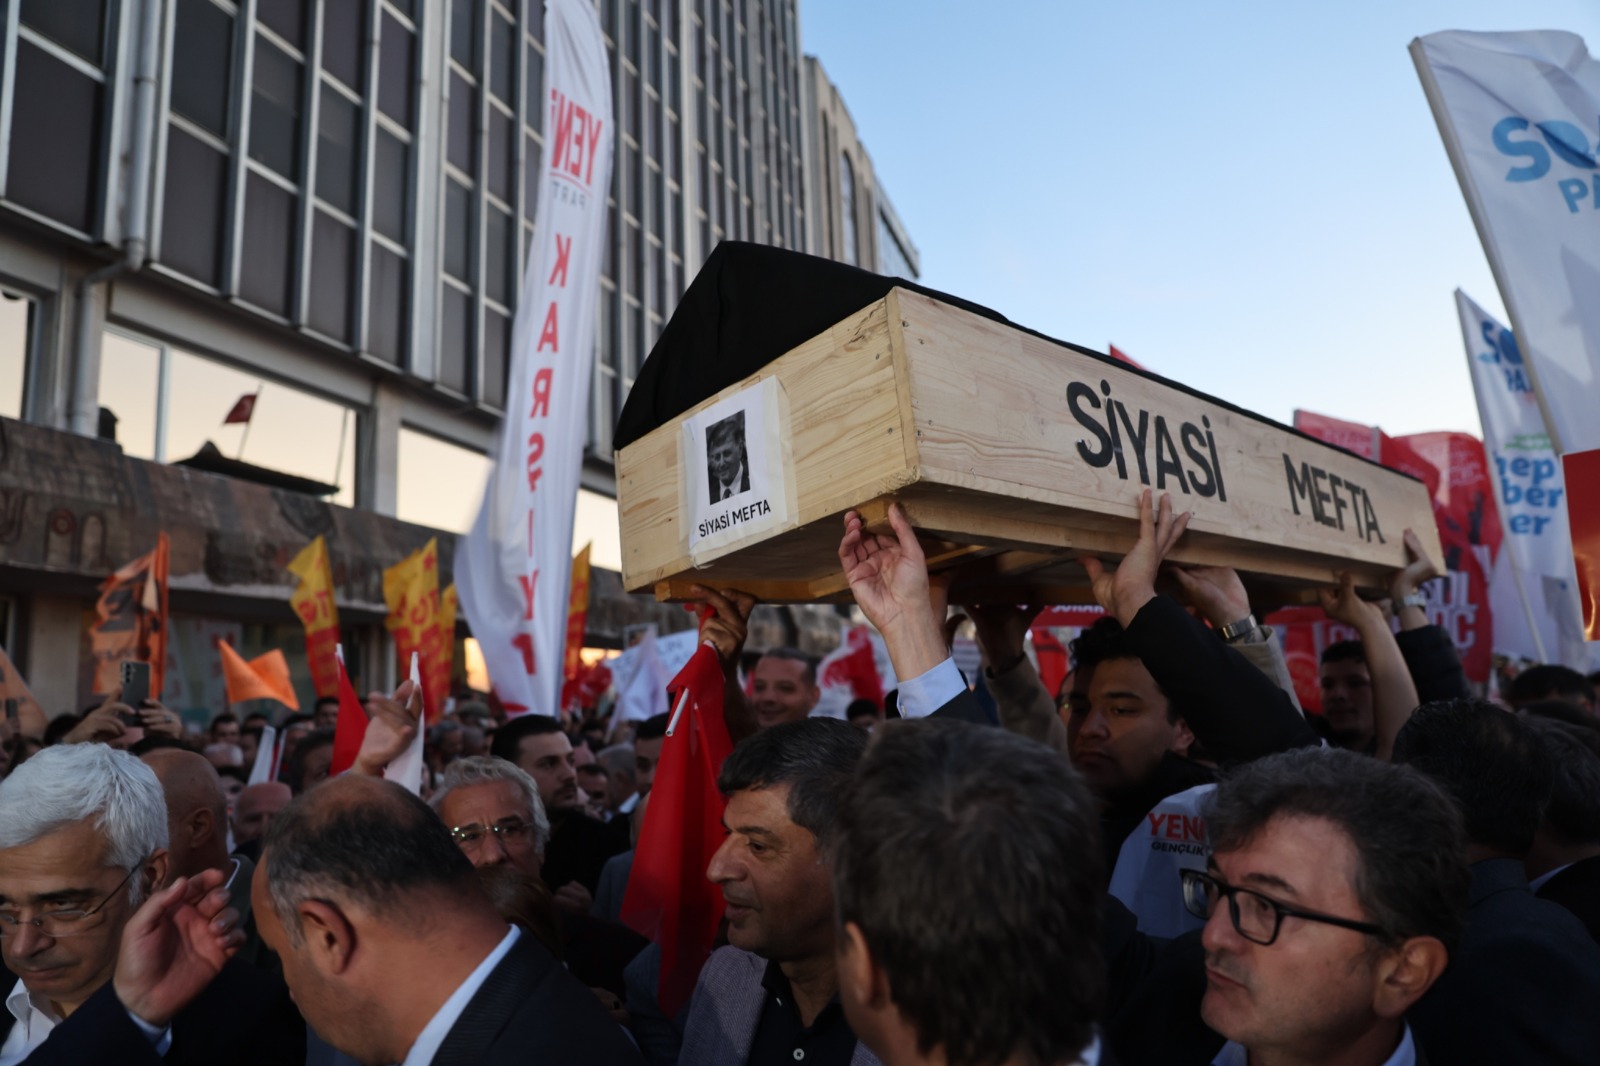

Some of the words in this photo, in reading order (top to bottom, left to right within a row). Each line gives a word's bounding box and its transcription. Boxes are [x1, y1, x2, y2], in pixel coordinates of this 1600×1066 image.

[1067, 379, 1227, 502] SİYASİ
[1282, 452, 1387, 544] MEFTA
[699, 510, 730, 538] SİYASİ
[732, 499, 771, 526] MEFTA
